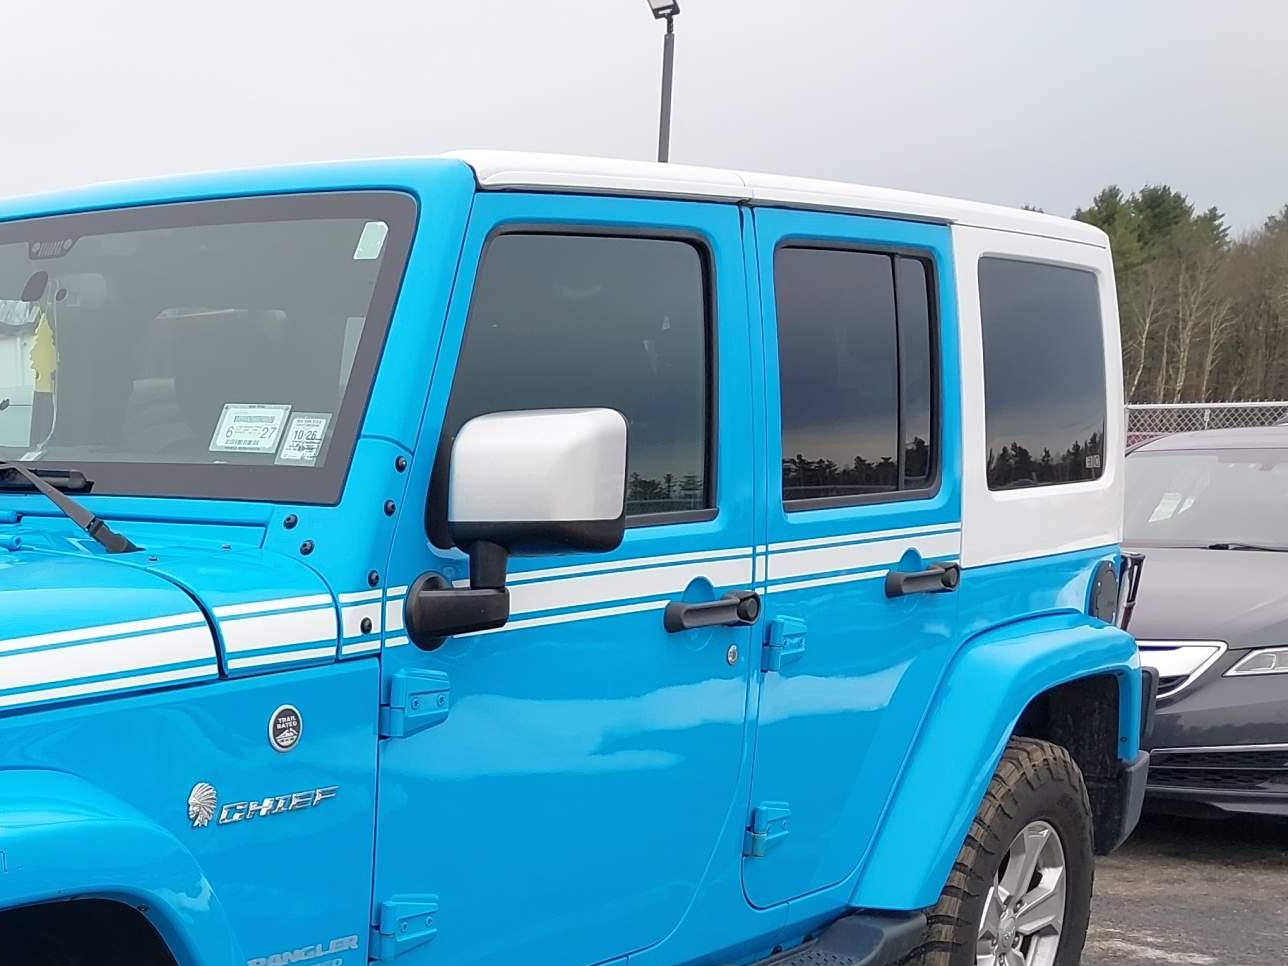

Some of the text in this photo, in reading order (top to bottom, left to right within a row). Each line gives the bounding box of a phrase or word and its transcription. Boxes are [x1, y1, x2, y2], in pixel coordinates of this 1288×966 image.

[225, 426, 234, 438] 6
[260, 427, 277, 439] 27
[277, 715, 297, 723] TRAIL
[276, 721, 298, 729] RATED
[218, 785, 340, 824] CHIEF
